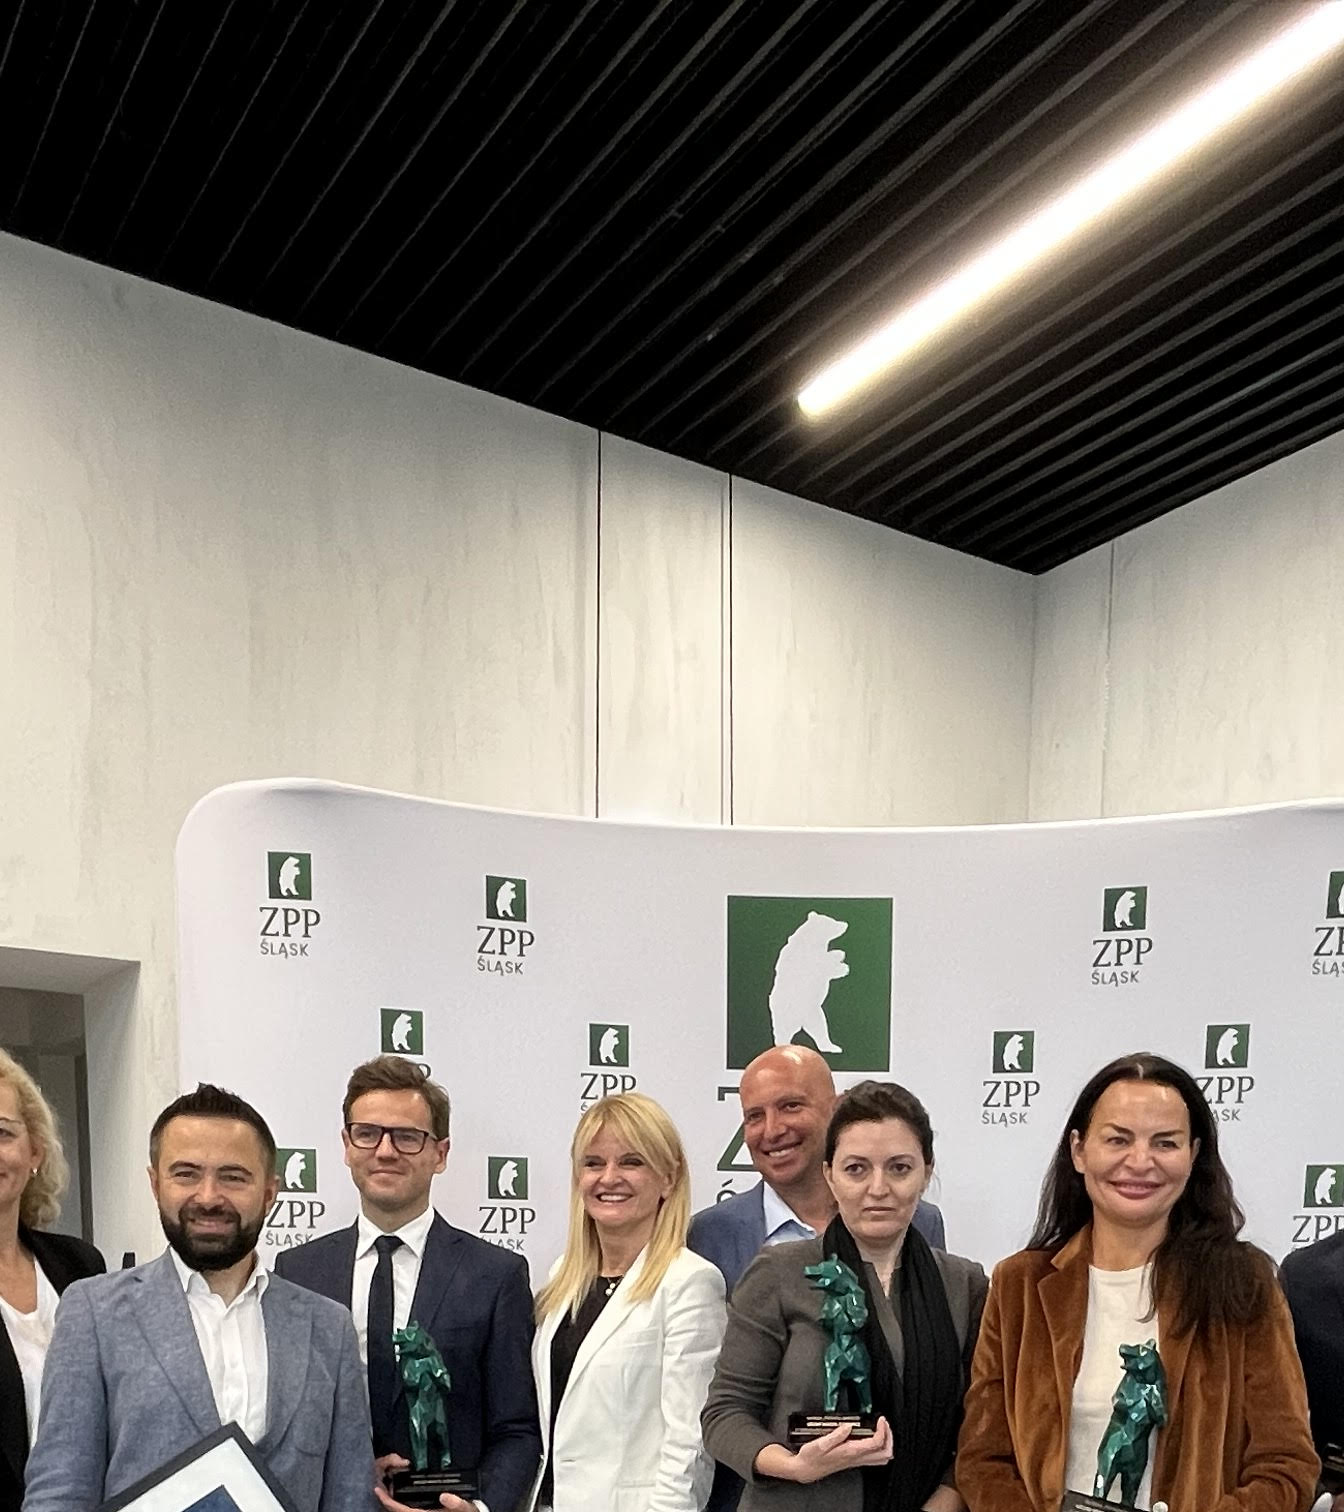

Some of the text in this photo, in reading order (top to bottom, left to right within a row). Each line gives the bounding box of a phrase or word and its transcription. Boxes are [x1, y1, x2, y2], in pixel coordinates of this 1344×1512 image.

[259, 907, 321, 938] ZPP
[260, 938, 309, 959] ŚLĄSK
[477, 925, 535, 957] ZPP
[1092, 938, 1153, 967] ZPP
[477, 955, 523, 976] ŚLĄSK
[1091, 969, 1140, 987] ŚLĄSK
[580, 1073, 637, 1099] ZPP
[982, 1081, 1041, 1107] ZPP
[981, 1109, 1028, 1127] ŚLĄSK
[266, 1200, 325, 1228] ZPP
[479, 1207, 536, 1234] ZPP
